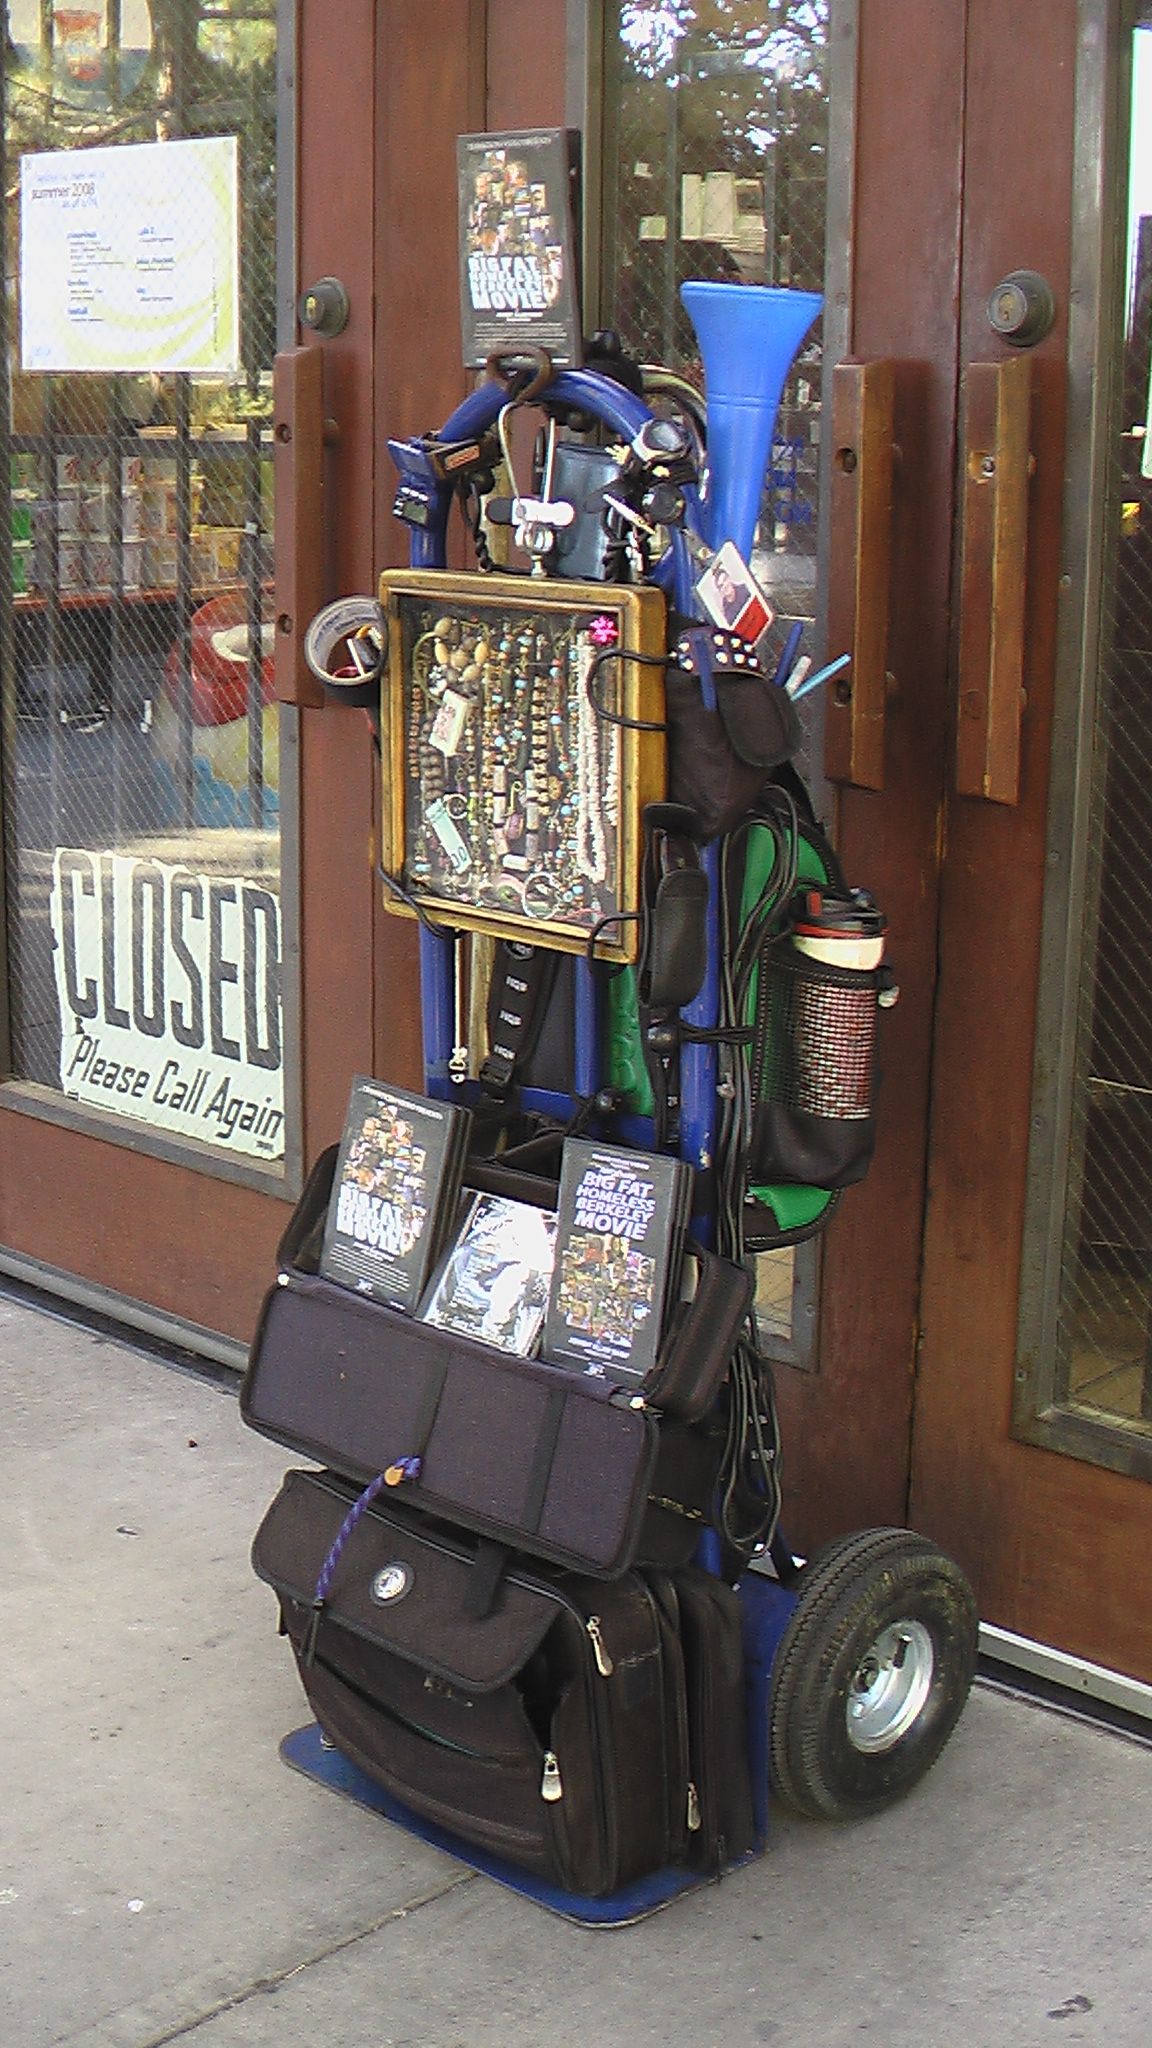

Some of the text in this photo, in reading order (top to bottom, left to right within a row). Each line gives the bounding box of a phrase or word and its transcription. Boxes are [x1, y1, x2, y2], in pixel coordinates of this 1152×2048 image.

[58, 850, 283, 1071] CLOSED
[66, 1034, 150, 1098] Please
[153, 1060, 210, 1115] Call
[202, 1077, 284, 1139] Again
[576, 1184, 656, 1212] HOMELESS
[582, 1170, 616, 1190] BIG
[617, 1179, 654, 1198] FAT
[575, 1197, 654, 1223] BERKELEY
[573, 1210, 648, 1241] MOVIE
